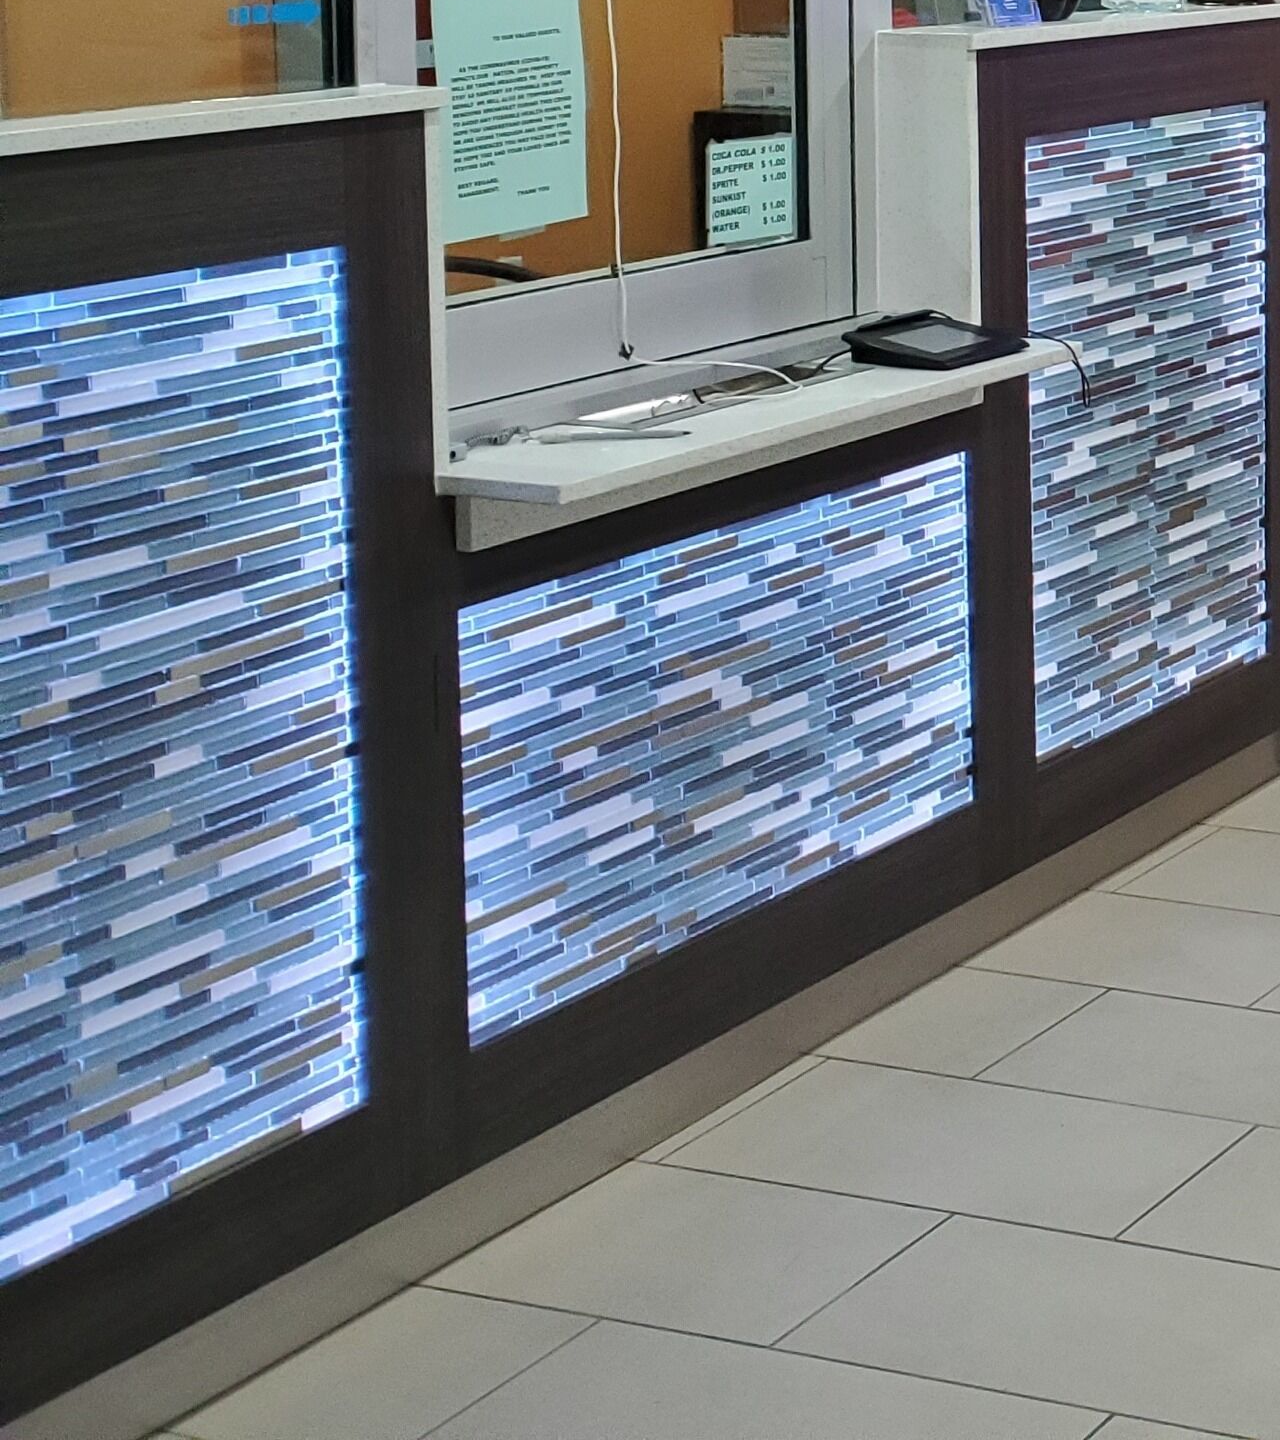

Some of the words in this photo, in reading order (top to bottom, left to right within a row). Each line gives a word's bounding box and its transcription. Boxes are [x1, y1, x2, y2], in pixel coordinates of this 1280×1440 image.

[712, 151, 732, 161] COCA
[734, 147, 757, 158] COLA
[760, 146, 766, 154] $
[769, 144, 786, 153] 1.00
[761, 160, 766, 168] $
[769, 158, 786, 167] 1.00
[712, 178, 739, 190] SPRITE
[762, 174, 767, 182] $
[770, 172, 787, 181] 1.00
[712, 191, 746, 204] SUNKIST
[712, 205, 751, 221] (ORANGE)
[762, 202, 767, 211] $
[770, 200, 786, 209] 1.00
[712, 222, 740, 233] WATER
[763, 216, 768, 225] $
[770, 214, 786, 223] 1.00
